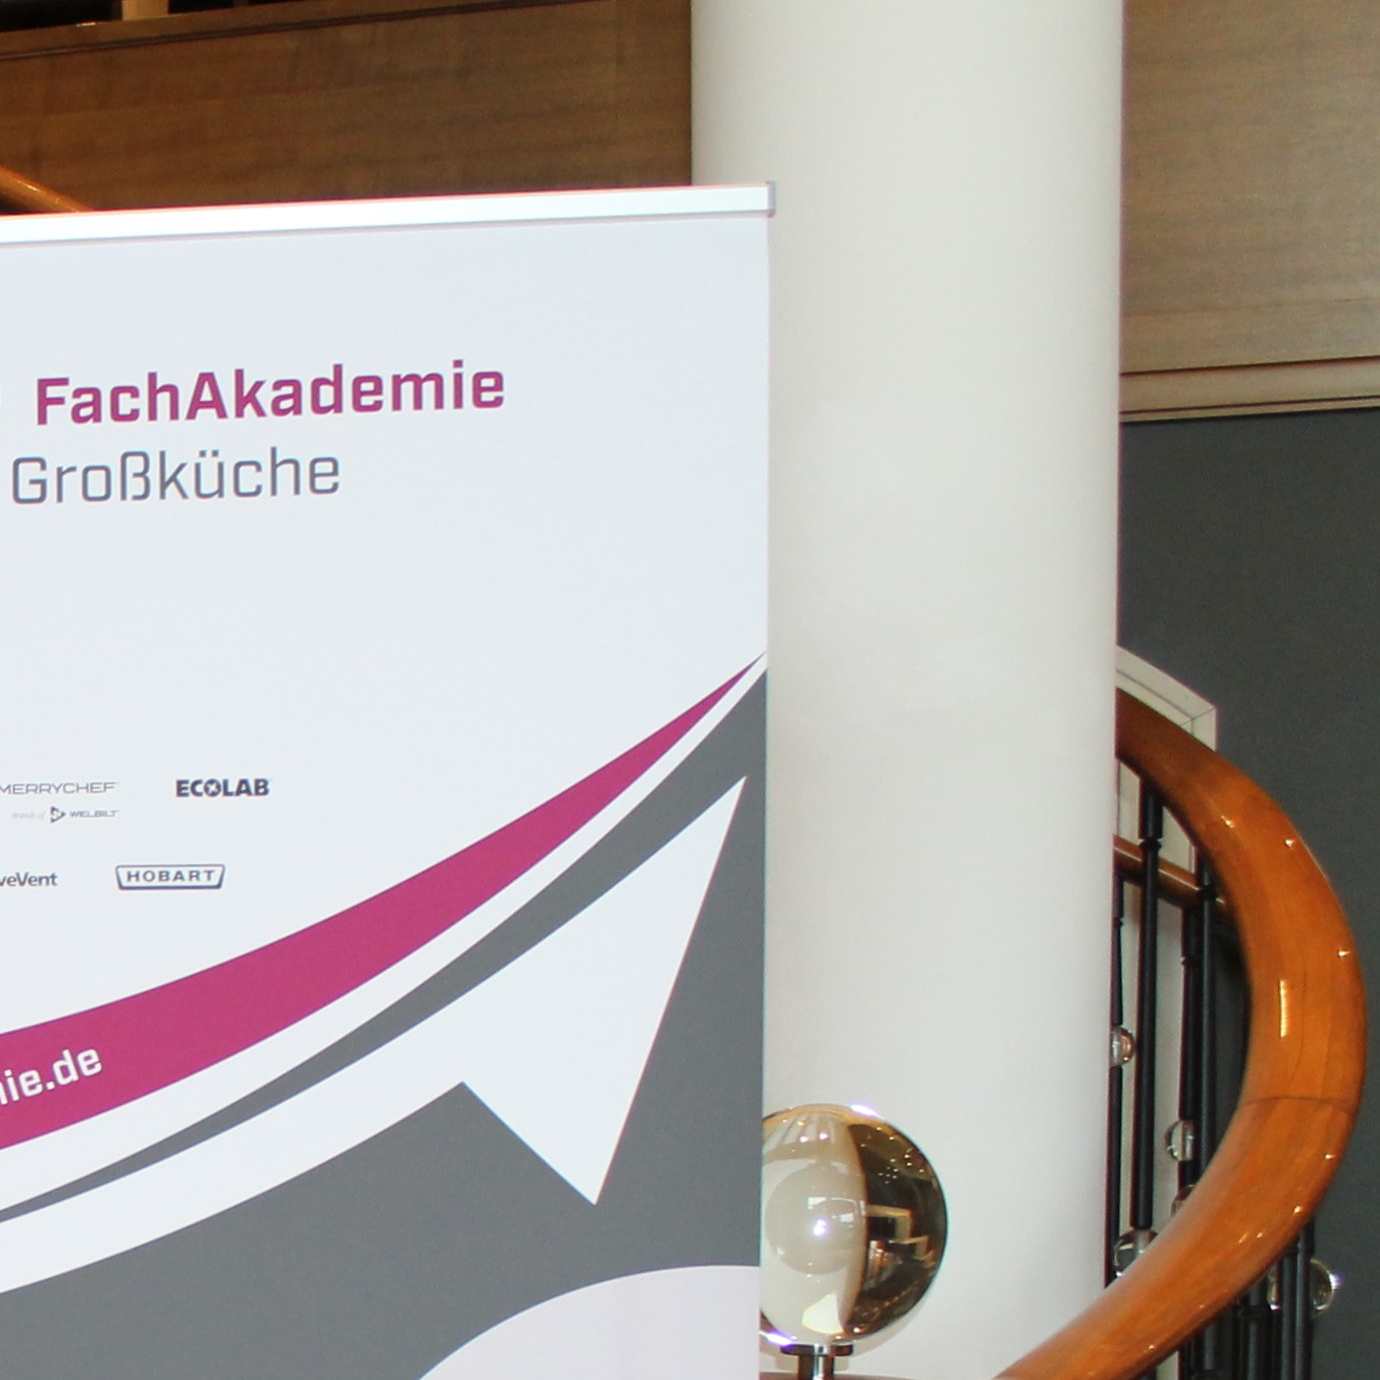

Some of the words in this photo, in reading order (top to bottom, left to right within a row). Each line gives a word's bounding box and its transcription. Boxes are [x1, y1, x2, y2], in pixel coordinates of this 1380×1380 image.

[36, 358, 504, 426] FachAkademie
[12, 446, 340, 505] Großküche
[175, 778, 270, 798] ECOLAB
[125, 868, 216, 883] HOBART
